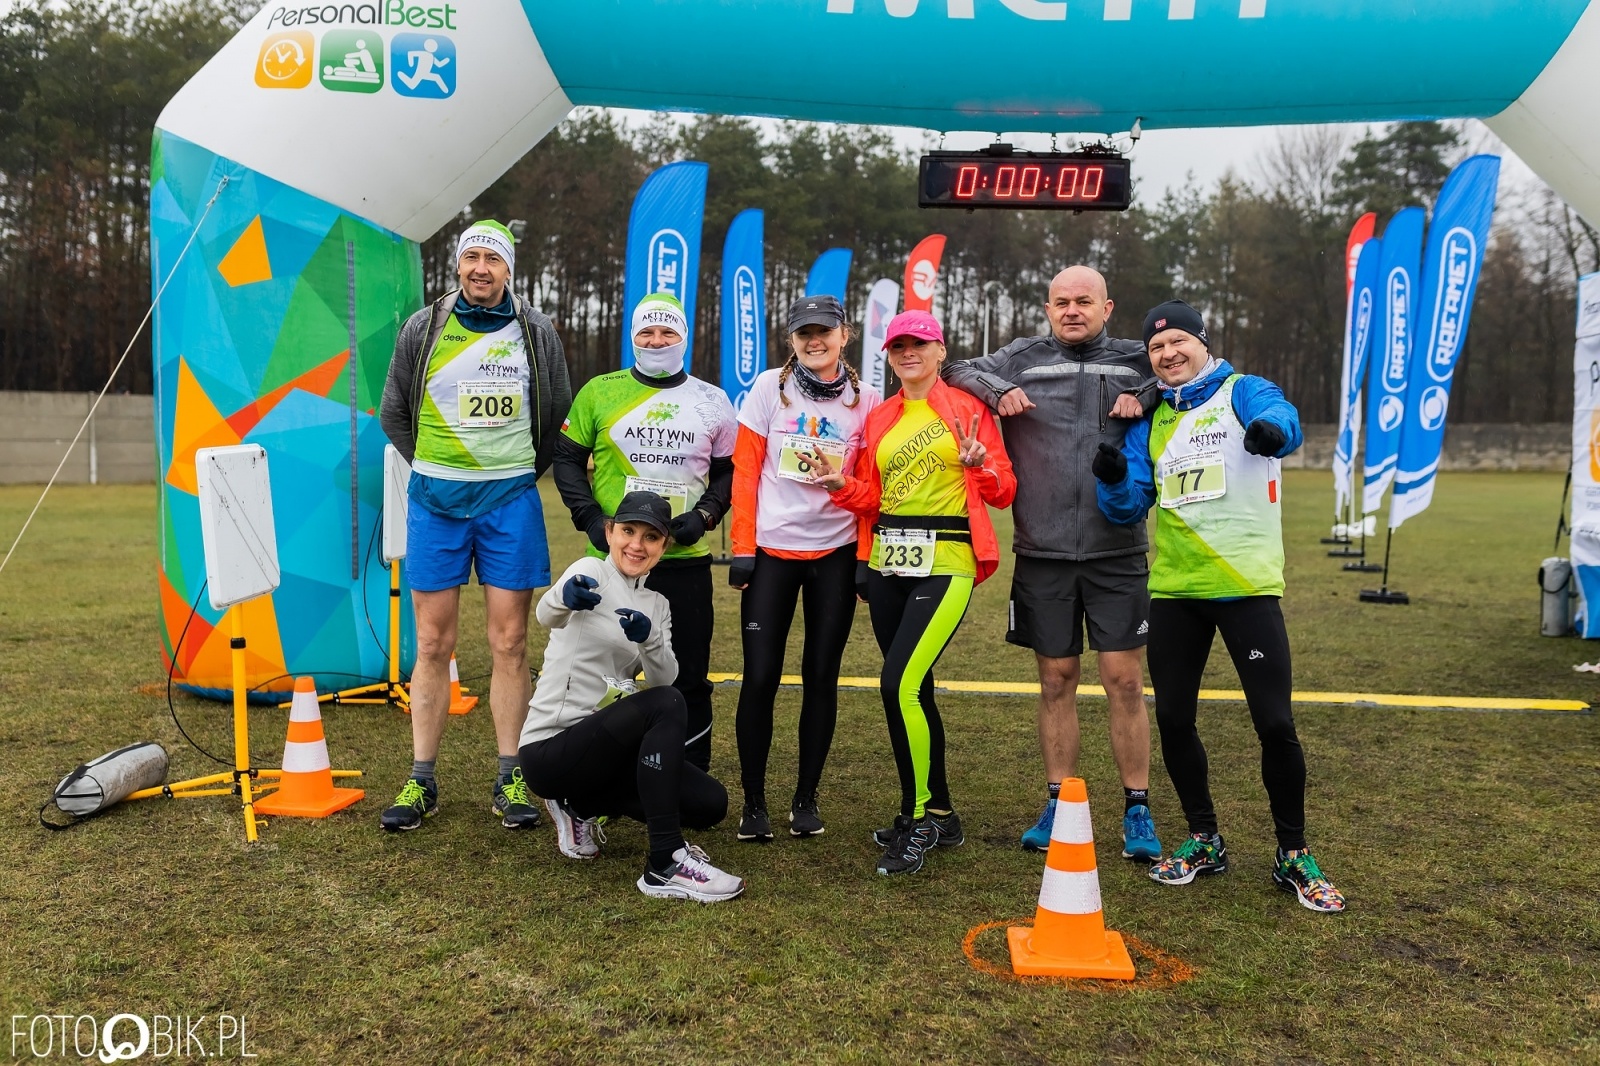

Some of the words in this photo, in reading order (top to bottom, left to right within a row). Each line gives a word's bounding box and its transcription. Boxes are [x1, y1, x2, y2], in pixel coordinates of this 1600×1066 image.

[957, 166, 1103, 198] 0:00:00
[1435, 239, 1468, 366] RAFAMET
[739, 275, 754, 374] RAFAMET
[1389, 277, 1406, 380] RAFAMET
[443, 333, 468, 343] deep
[478, 363, 519, 374] AKTYWNI
[602, 373, 628, 382] deep
[871, 353, 884, 393] tury
[469, 396, 513, 418] 208
[624, 427, 695, 444] AKTYWNI
[640, 439, 681, 449] LYSKI
[1189, 431, 1228, 445] AKTYWNI
[1196, 440, 1221, 448] LYSKI
[629, 453, 687, 466] GEOFART
[1177, 468, 1205, 495] 77
[884, 545, 924, 568] 233
